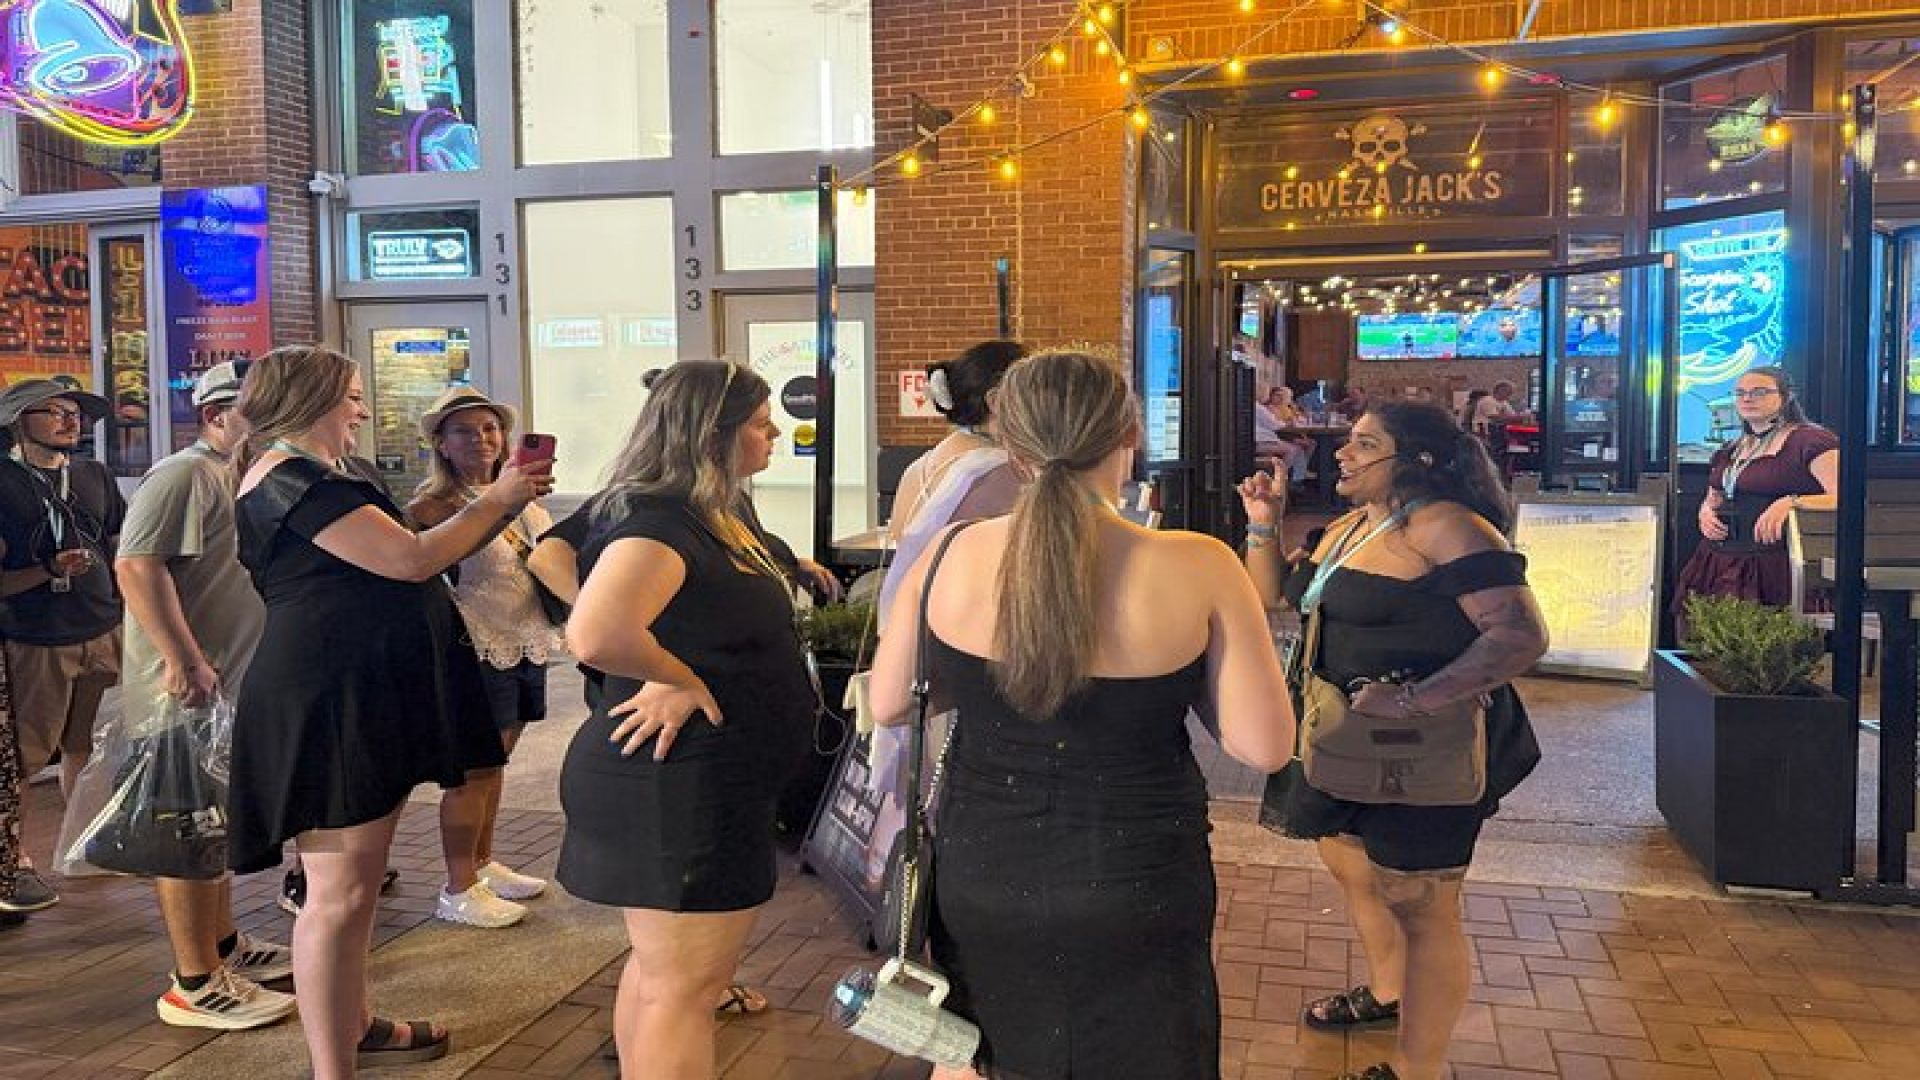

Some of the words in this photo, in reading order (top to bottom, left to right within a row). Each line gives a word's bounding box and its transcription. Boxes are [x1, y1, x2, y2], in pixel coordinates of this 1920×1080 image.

[1261, 177, 1391, 211] CERVEZA
[1400, 170, 1502, 204] JACK'S
[373, 237, 428, 256] TRULY
[684, 224, 702, 312] 133
[0, 250, 89, 298] AC
[495, 232, 510, 316] 131
